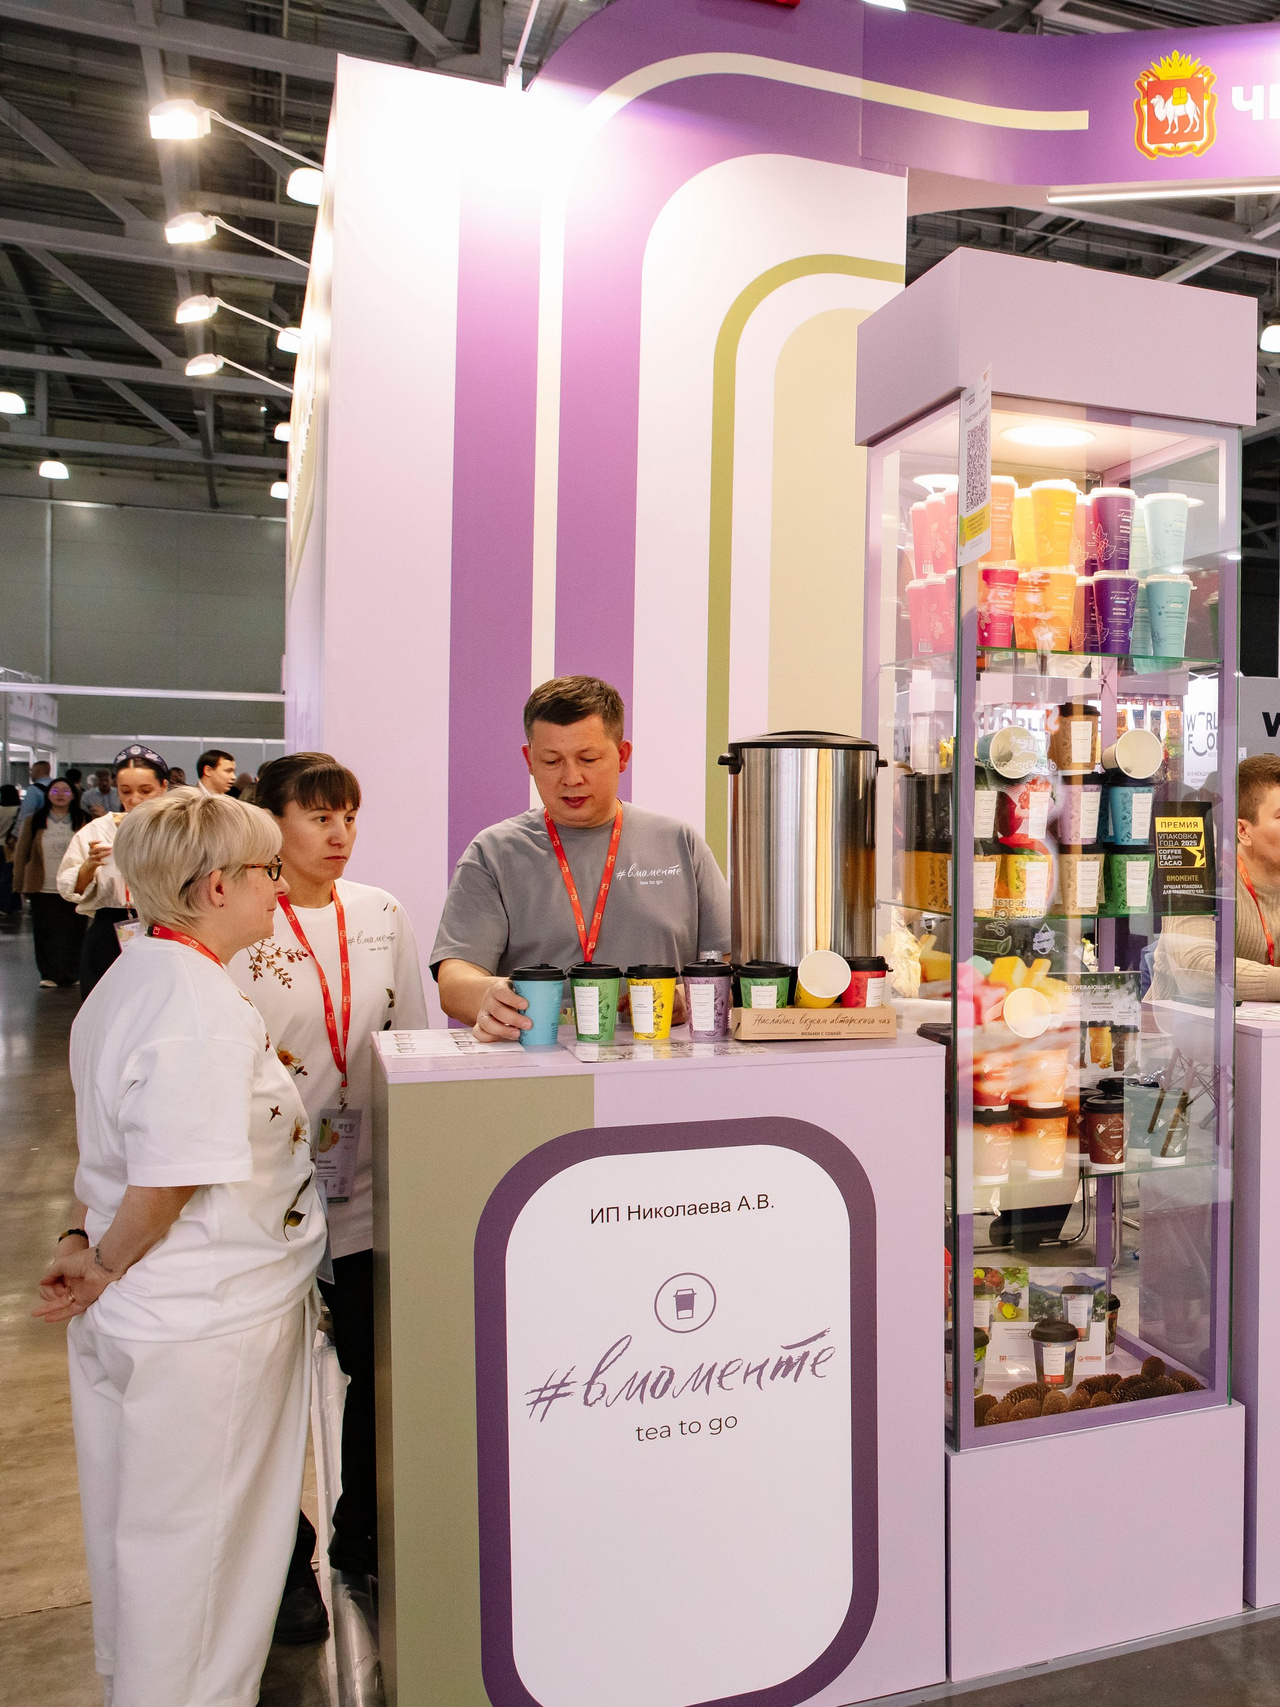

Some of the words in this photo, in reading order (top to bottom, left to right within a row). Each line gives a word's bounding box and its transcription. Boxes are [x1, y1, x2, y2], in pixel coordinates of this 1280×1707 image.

[1160, 821, 1199, 829] ПРЕМИЯ
[615, 862, 682, 880] #вмоменте
[751, 1013, 796, 1026] Насладись
[799, 1013, 828, 1030] вкусом
[829, 1014, 875, 1029] авторского
[589, 1206, 620, 1224] ИП
[627, 1198, 732, 1221] Николаева
[737, 1193, 775, 1211] А.В.
[524, 1327, 836, 1423] #вмоменте
[635, 1423, 671, 1442] tea
[678, 1419, 701, 1436] to
[708, 1415, 738, 1435] go
